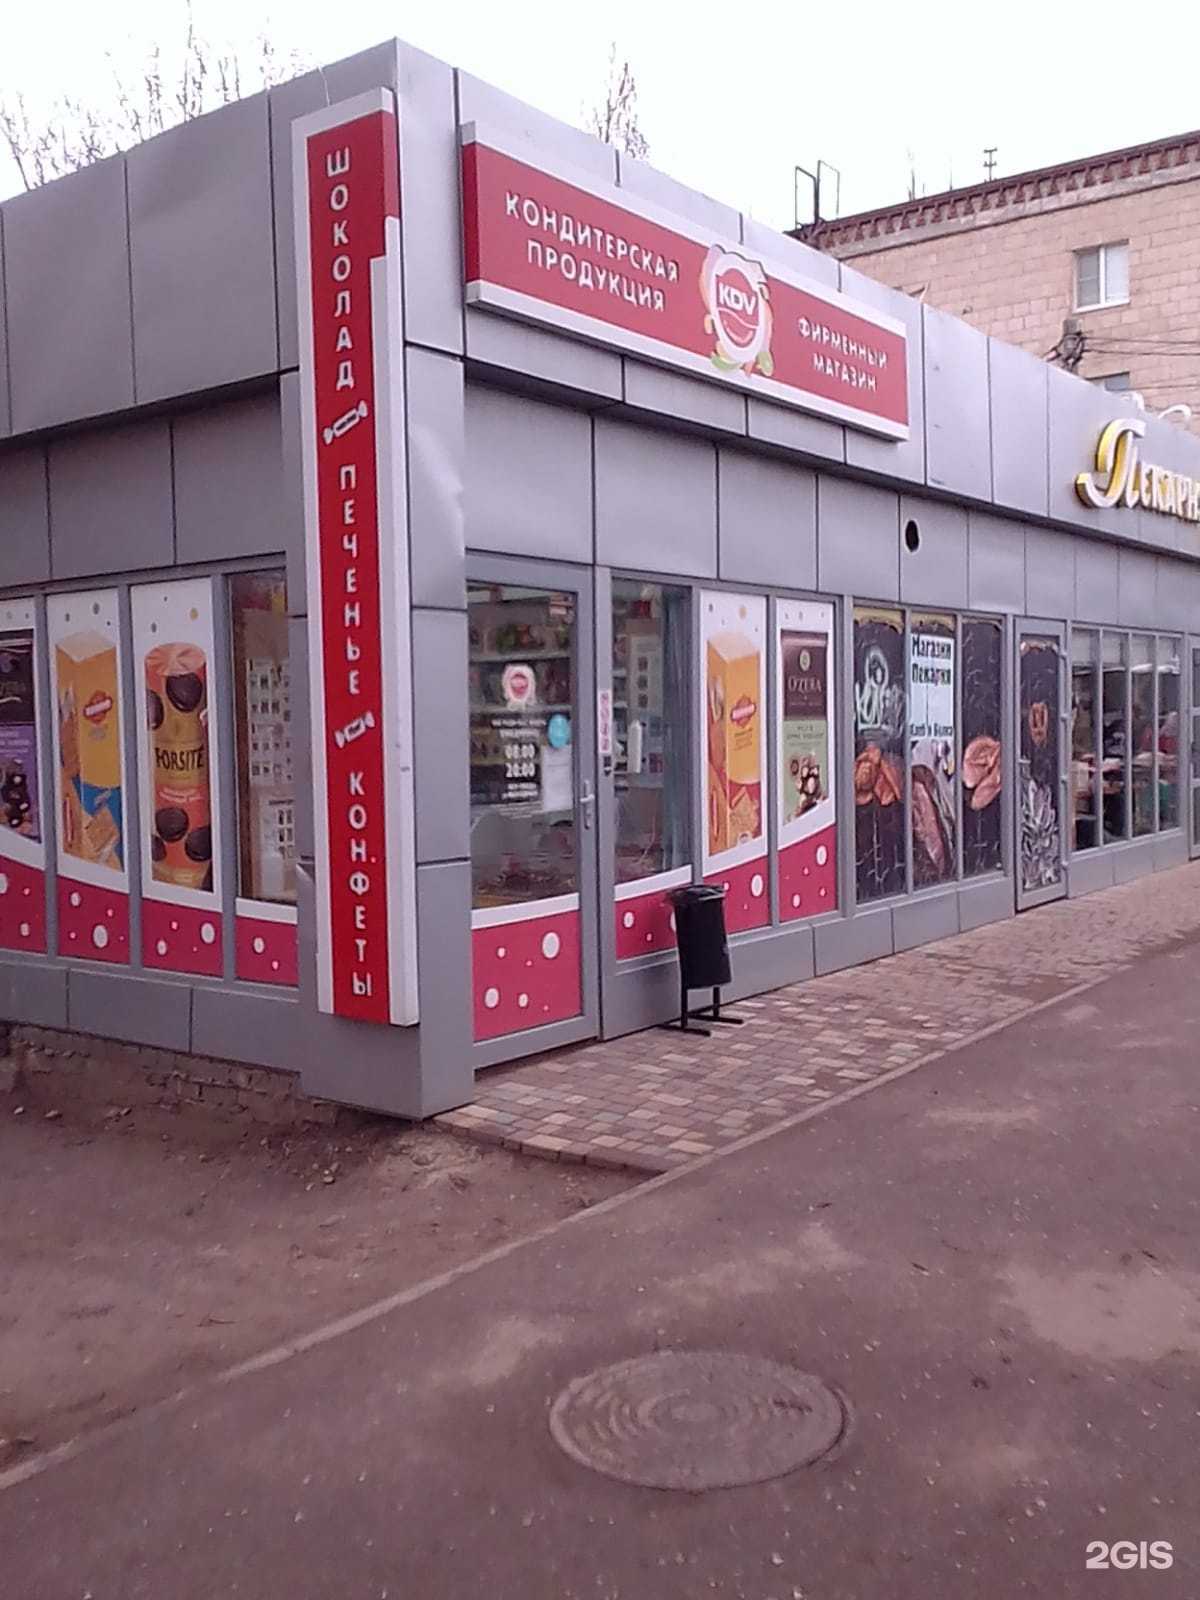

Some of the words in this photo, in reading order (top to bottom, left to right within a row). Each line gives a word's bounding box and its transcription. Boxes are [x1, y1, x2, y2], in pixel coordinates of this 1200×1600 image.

[325, 147, 355, 391] ШОКОЛАД
[505, 191, 680, 282] КОНДИТЕРСКАЯ
[527, 240, 665, 312] ПРОДУКЦИЯ
[717, 282, 756, 316] KDV
[798, 316, 888, 369] ФИРМЕННЫЙ
[812, 352, 877, 392] МАГАЗИН
[340, 464, 361, 695] ПЕЧЕНЬЕ
[155, 745, 204, 771] FORSITE
[349, 771, 372, 997] КОНФЕТЫ
